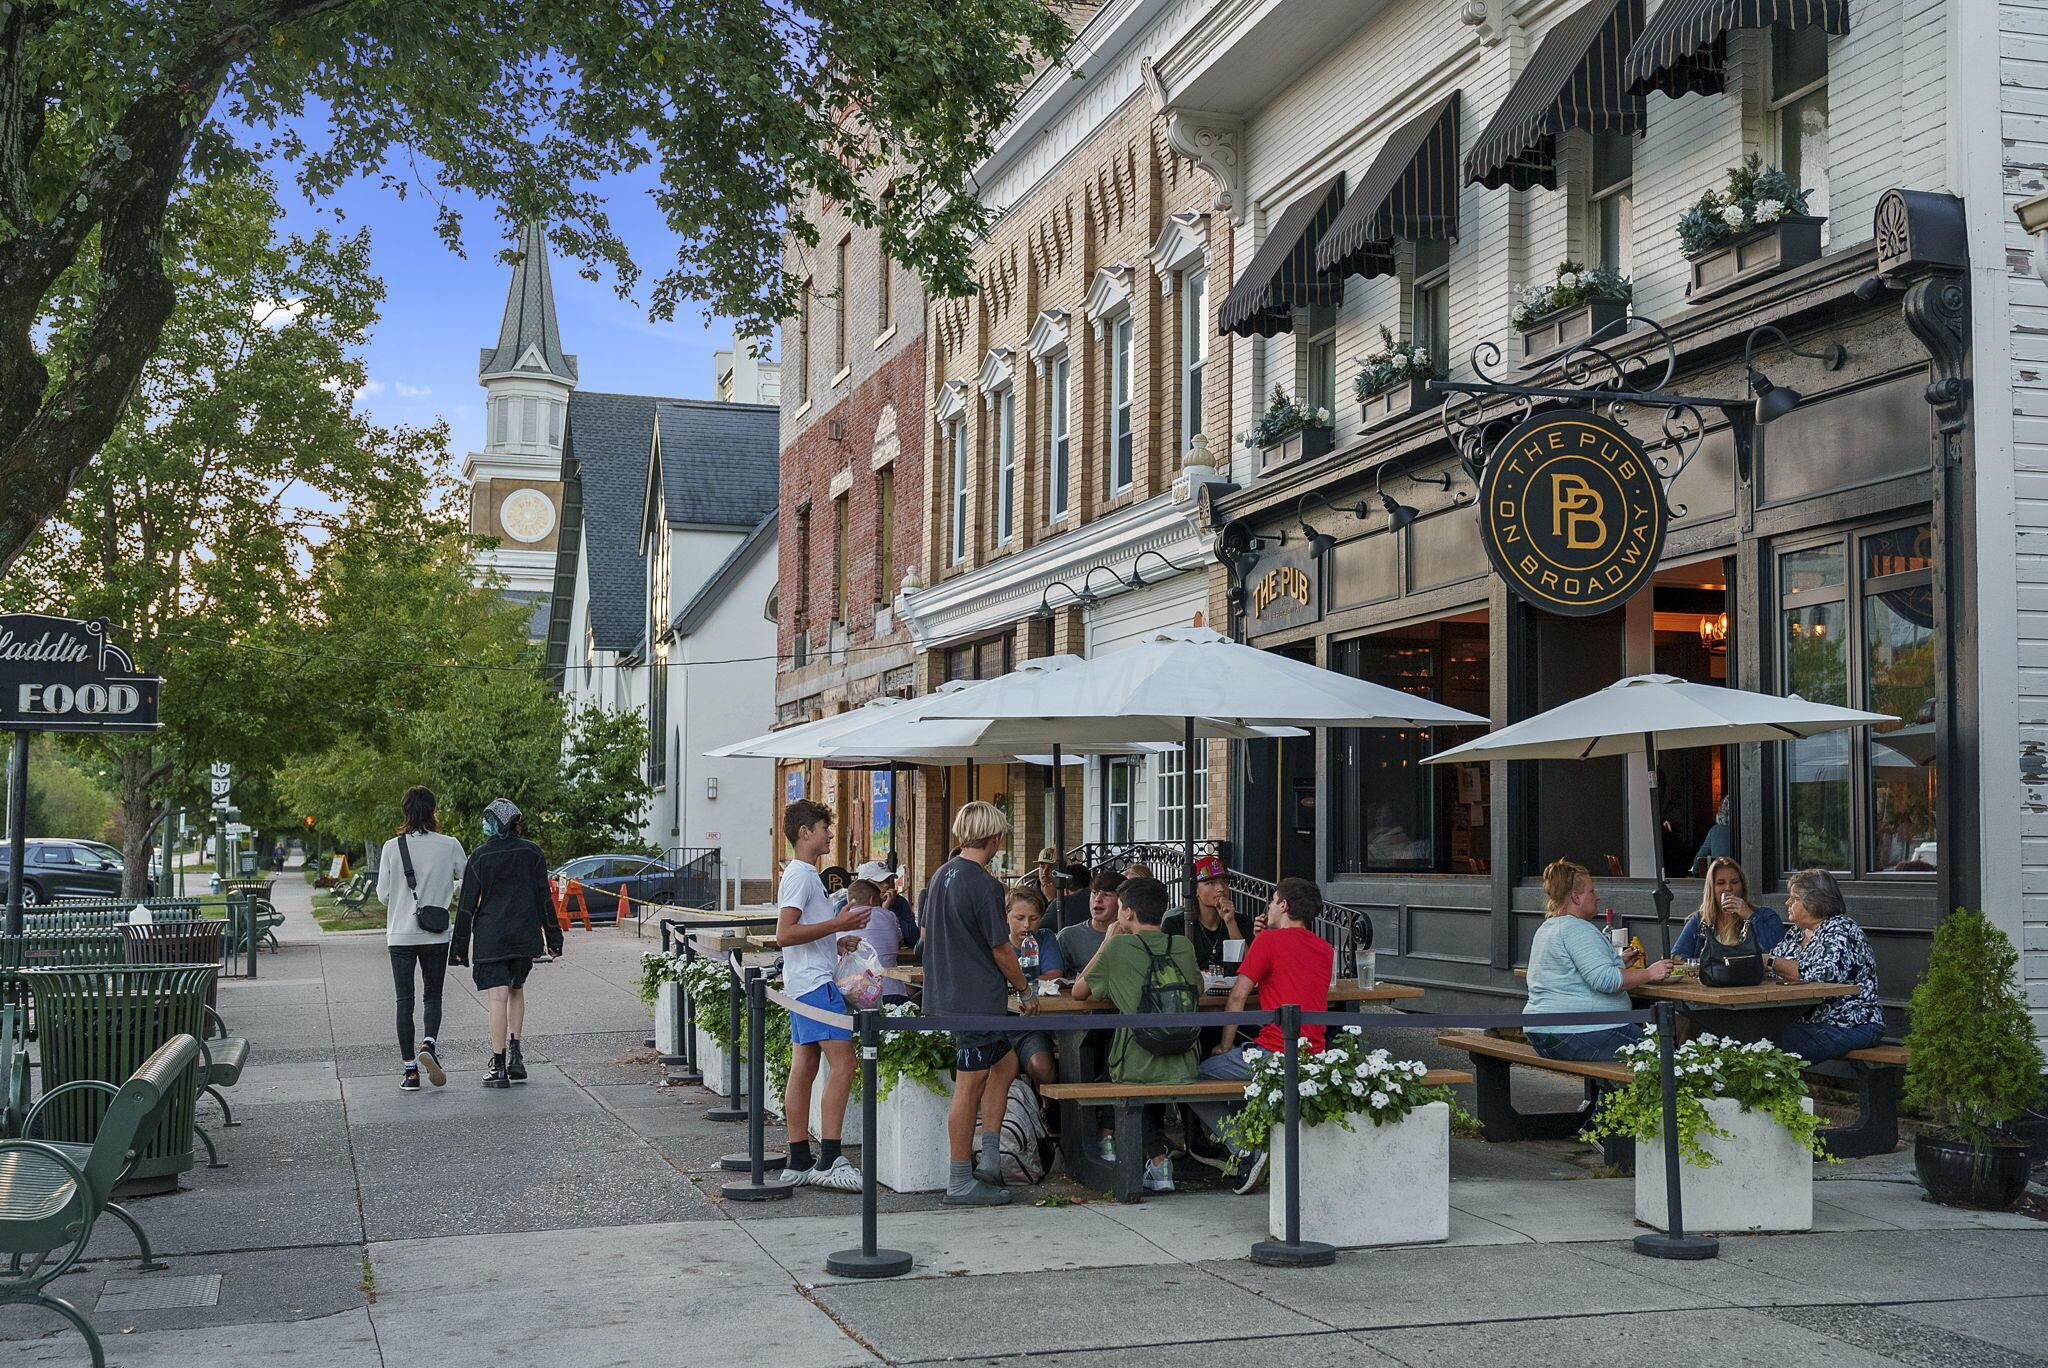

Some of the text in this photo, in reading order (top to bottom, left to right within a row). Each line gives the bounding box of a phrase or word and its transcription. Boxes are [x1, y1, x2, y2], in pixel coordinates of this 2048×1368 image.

[1508, 432, 1637, 480] THE PUB
[1550, 473, 1607, 550] PB
[1499, 501, 1649, 595] ON BROADWAY
[1252, 566, 1309, 619] THE PUB
[0, 629, 92, 662] laddin
[18, 683, 140, 714] FOOD
[214, 781, 228, 792] 37
